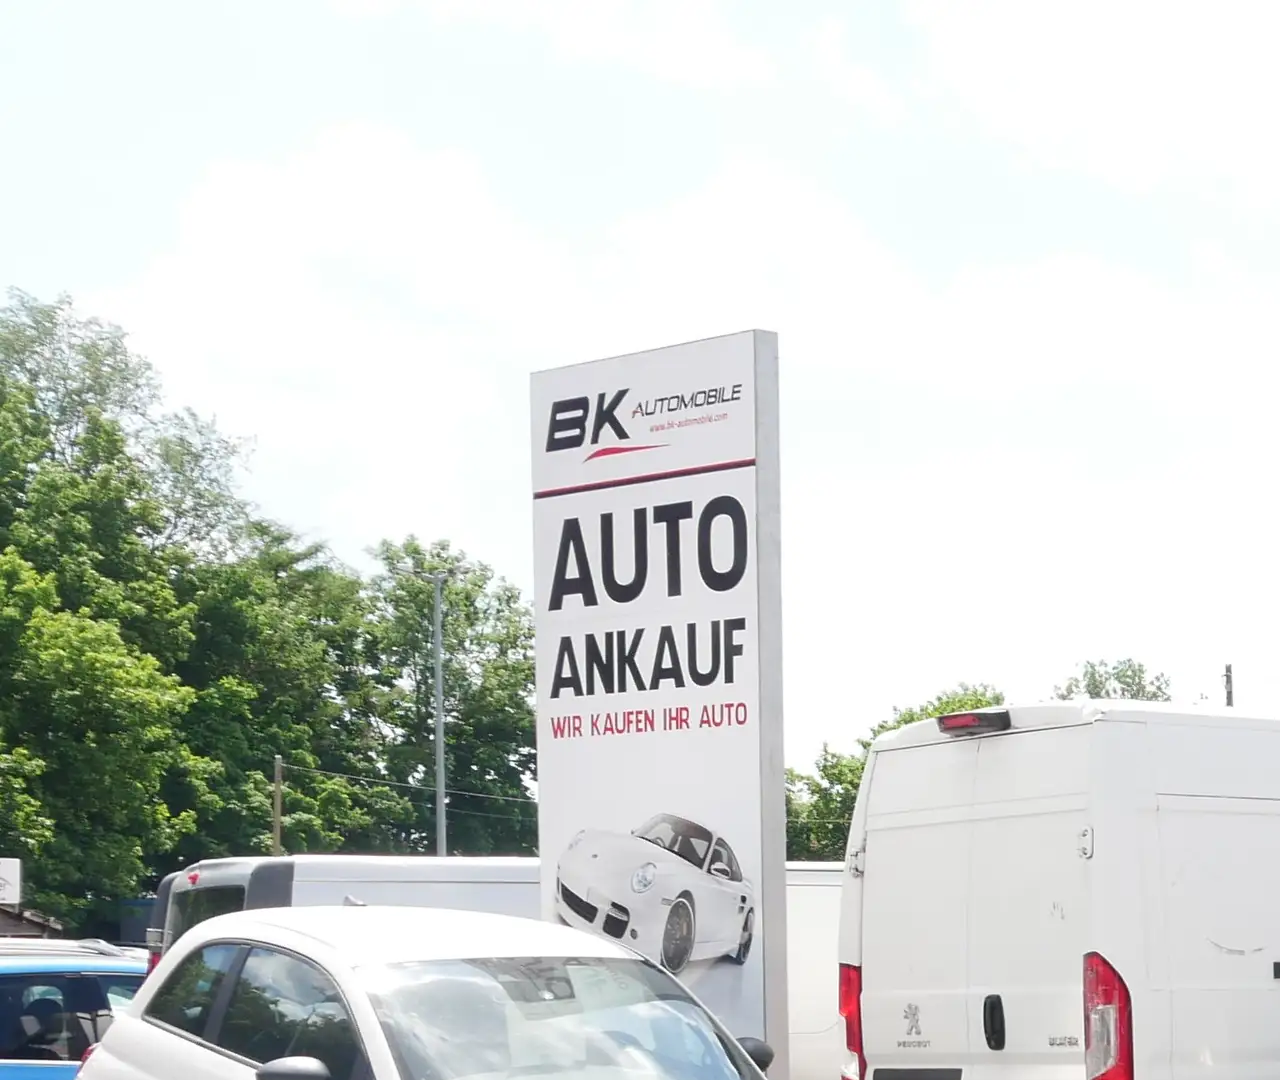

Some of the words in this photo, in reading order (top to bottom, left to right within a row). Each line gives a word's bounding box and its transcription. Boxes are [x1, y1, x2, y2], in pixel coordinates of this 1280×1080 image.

[546, 388, 630, 452] BK
[632, 384, 742, 419] AUTOMOBILE
[548, 495, 748, 612] AUTO
[550, 617, 746, 699] ANKAUF
[551, 715, 583, 739] WIR
[590, 709, 655, 736] KAUFEN
[663, 706, 690, 731] IHR
[699, 702, 748, 728] AUTO
